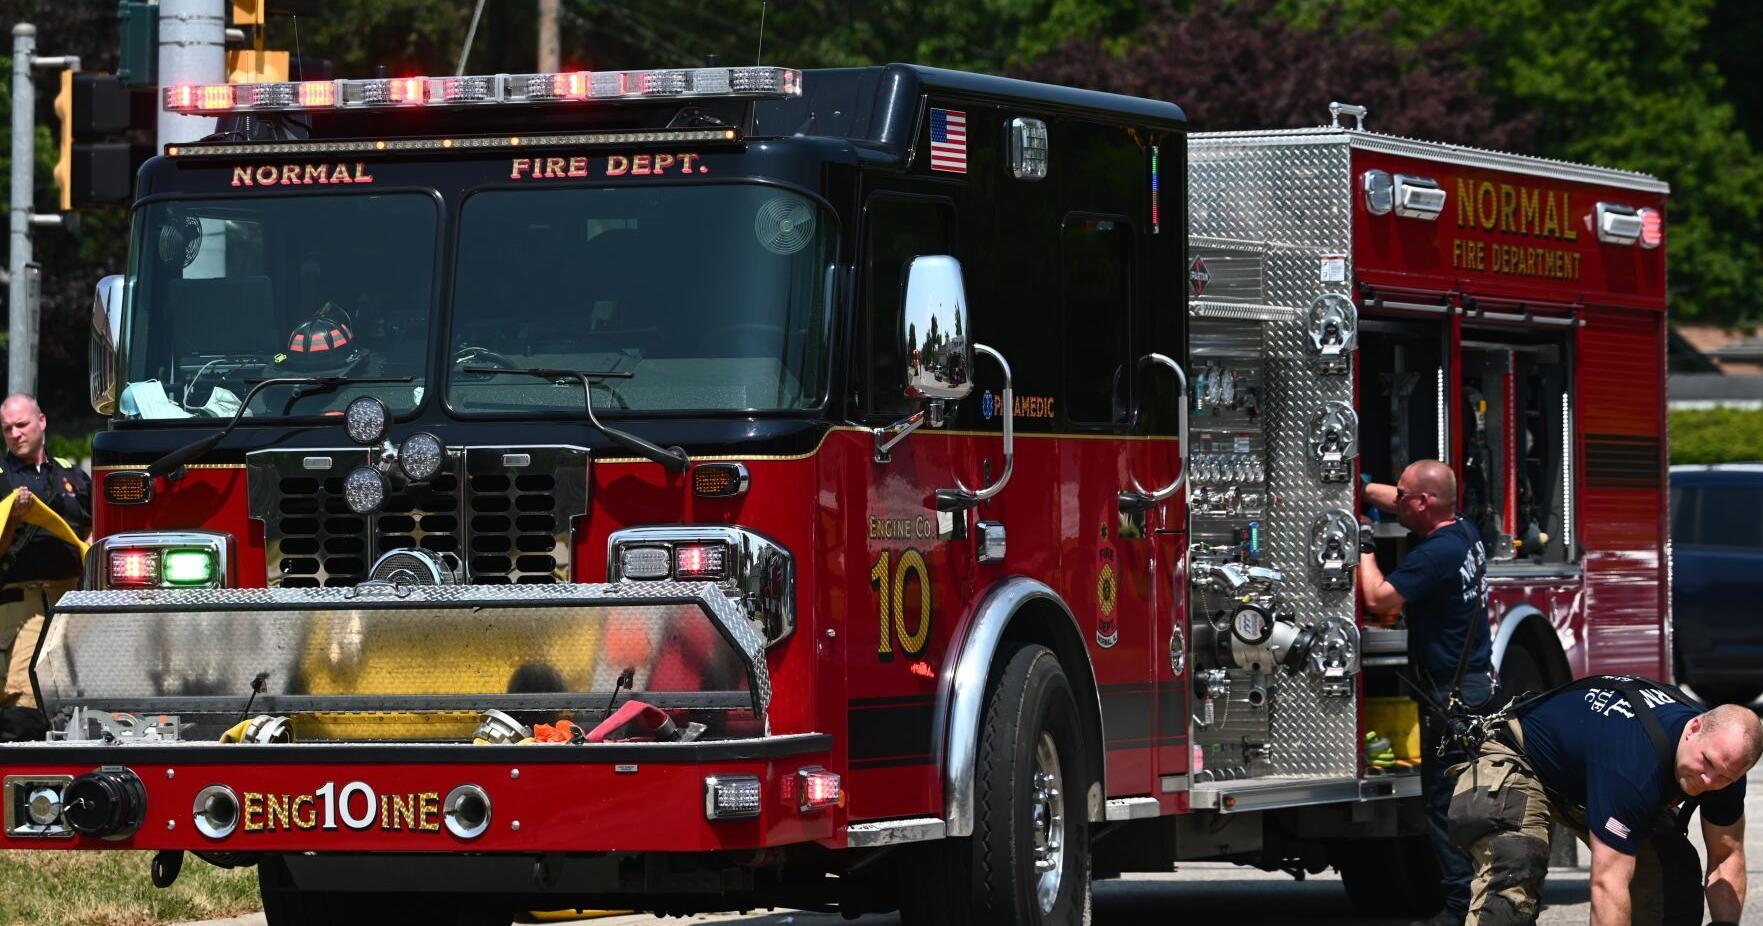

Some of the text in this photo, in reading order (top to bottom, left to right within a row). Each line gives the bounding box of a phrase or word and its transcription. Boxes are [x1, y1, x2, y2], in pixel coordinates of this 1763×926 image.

[231, 153, 708, 186] NORMAL FIRE DEPT.
[1457, 177, 1577, 240] NORMAL
[1453, 238, 1580, 279] FIRE DEPARTMENT
[869, 515, 912, 539] ENGINE
[871, 549, 931, 657] 10
